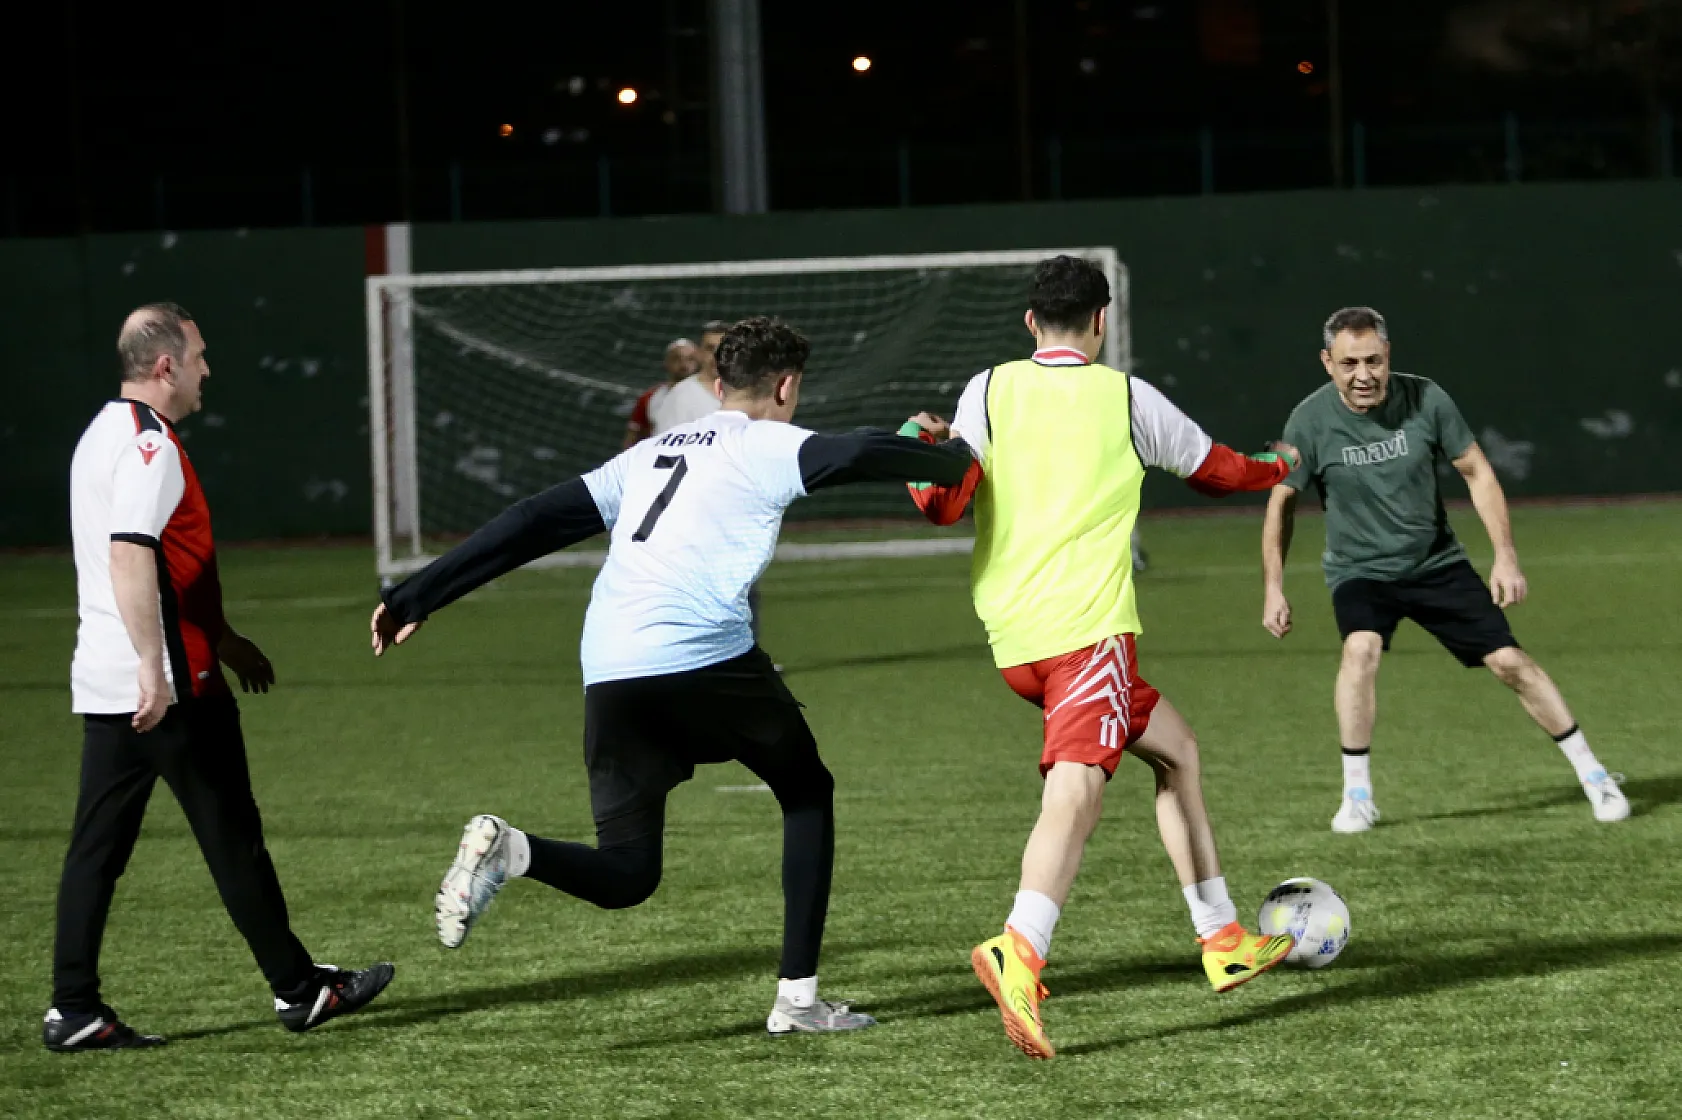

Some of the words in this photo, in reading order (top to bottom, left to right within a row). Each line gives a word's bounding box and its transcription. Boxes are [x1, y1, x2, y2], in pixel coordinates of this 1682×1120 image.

[1341, 429, 1408, 467] mavi
[631, 453, 688, 542] 7
[1099, 714, 1118, 749] 11
